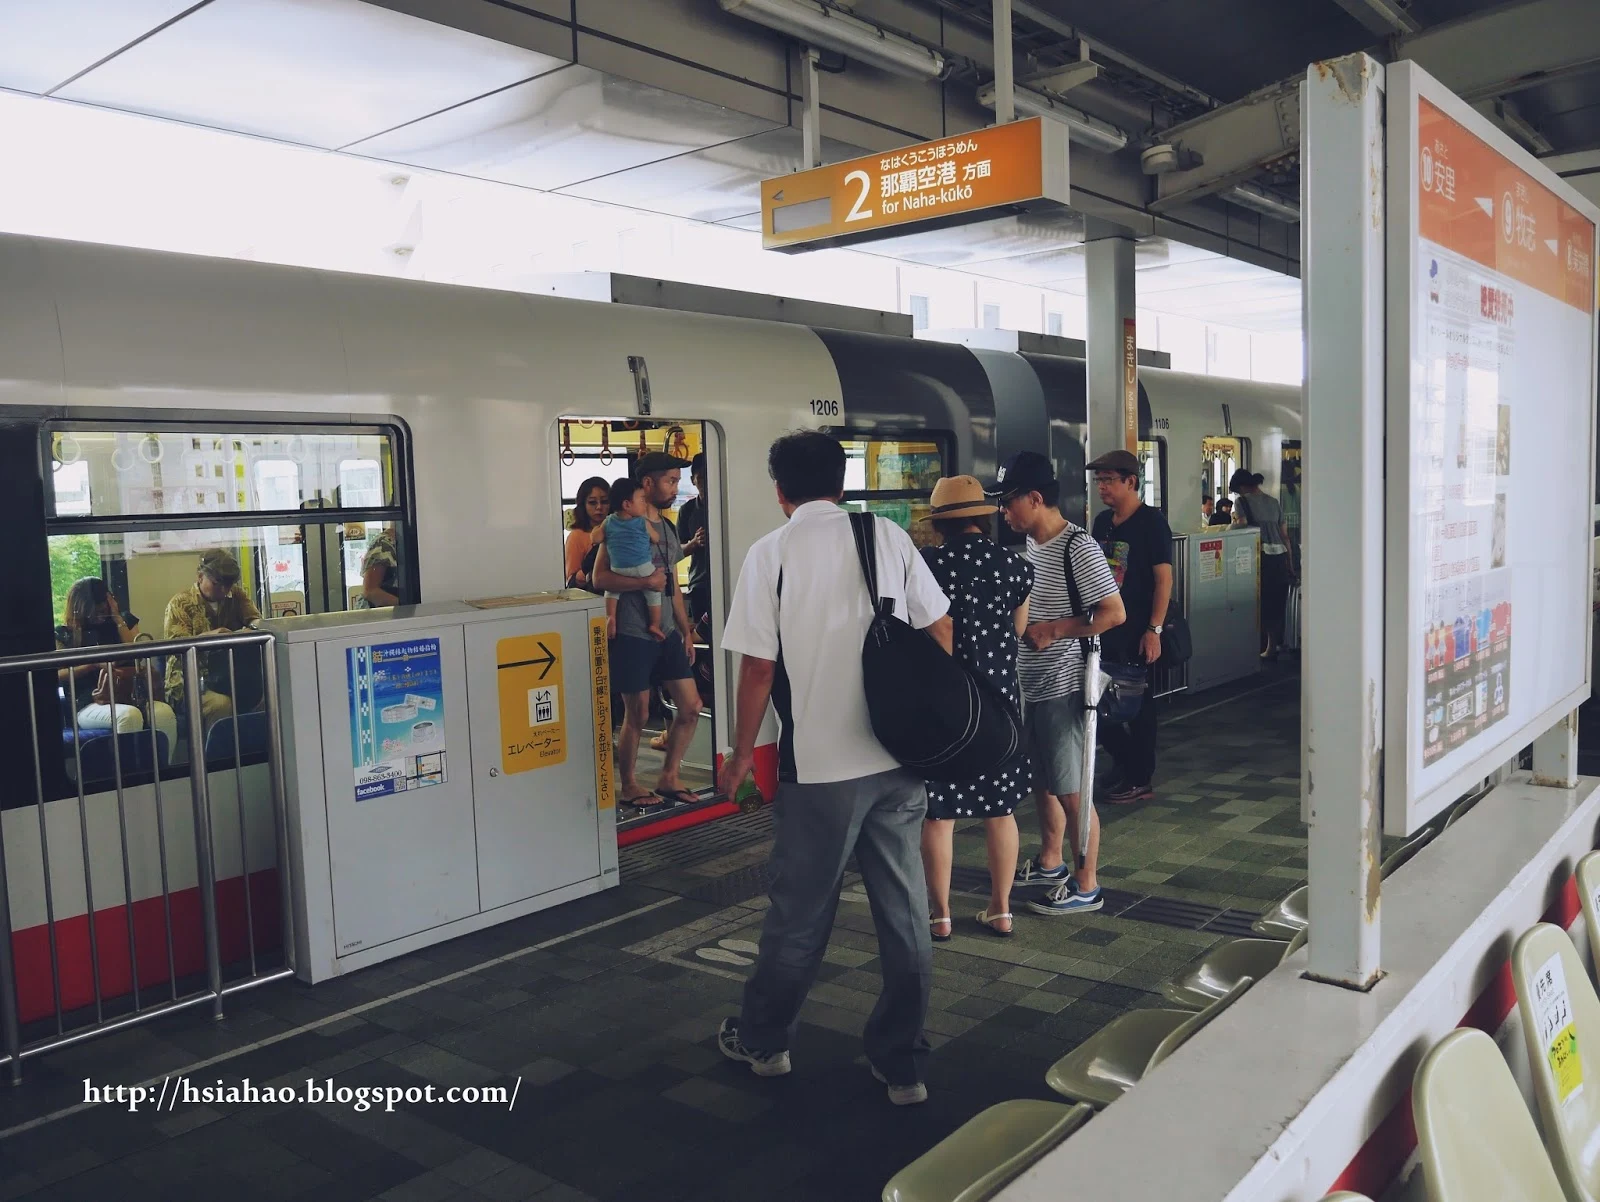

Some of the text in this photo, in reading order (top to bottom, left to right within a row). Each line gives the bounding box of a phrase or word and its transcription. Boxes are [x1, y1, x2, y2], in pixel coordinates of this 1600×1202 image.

[880, 139, 978, 170] なはくうこうほうめん
[880, 159, 991, 198] 那覇空港 方面
[1434, 161, 1456, 202] 安里
[844, 169, 873, 222] 2
[881, 185, 973, 214] for Naha-kūkō
[1516, 206, 1537, 251] 牧志
[810, 399, 839, 416] 1206
[1155, 418, 1170, 430] 1106
[508, 738, 561, 755] エレベーター
[539, 748, 561, 758] Elevator
[356, 784, 385, 796] facebook
